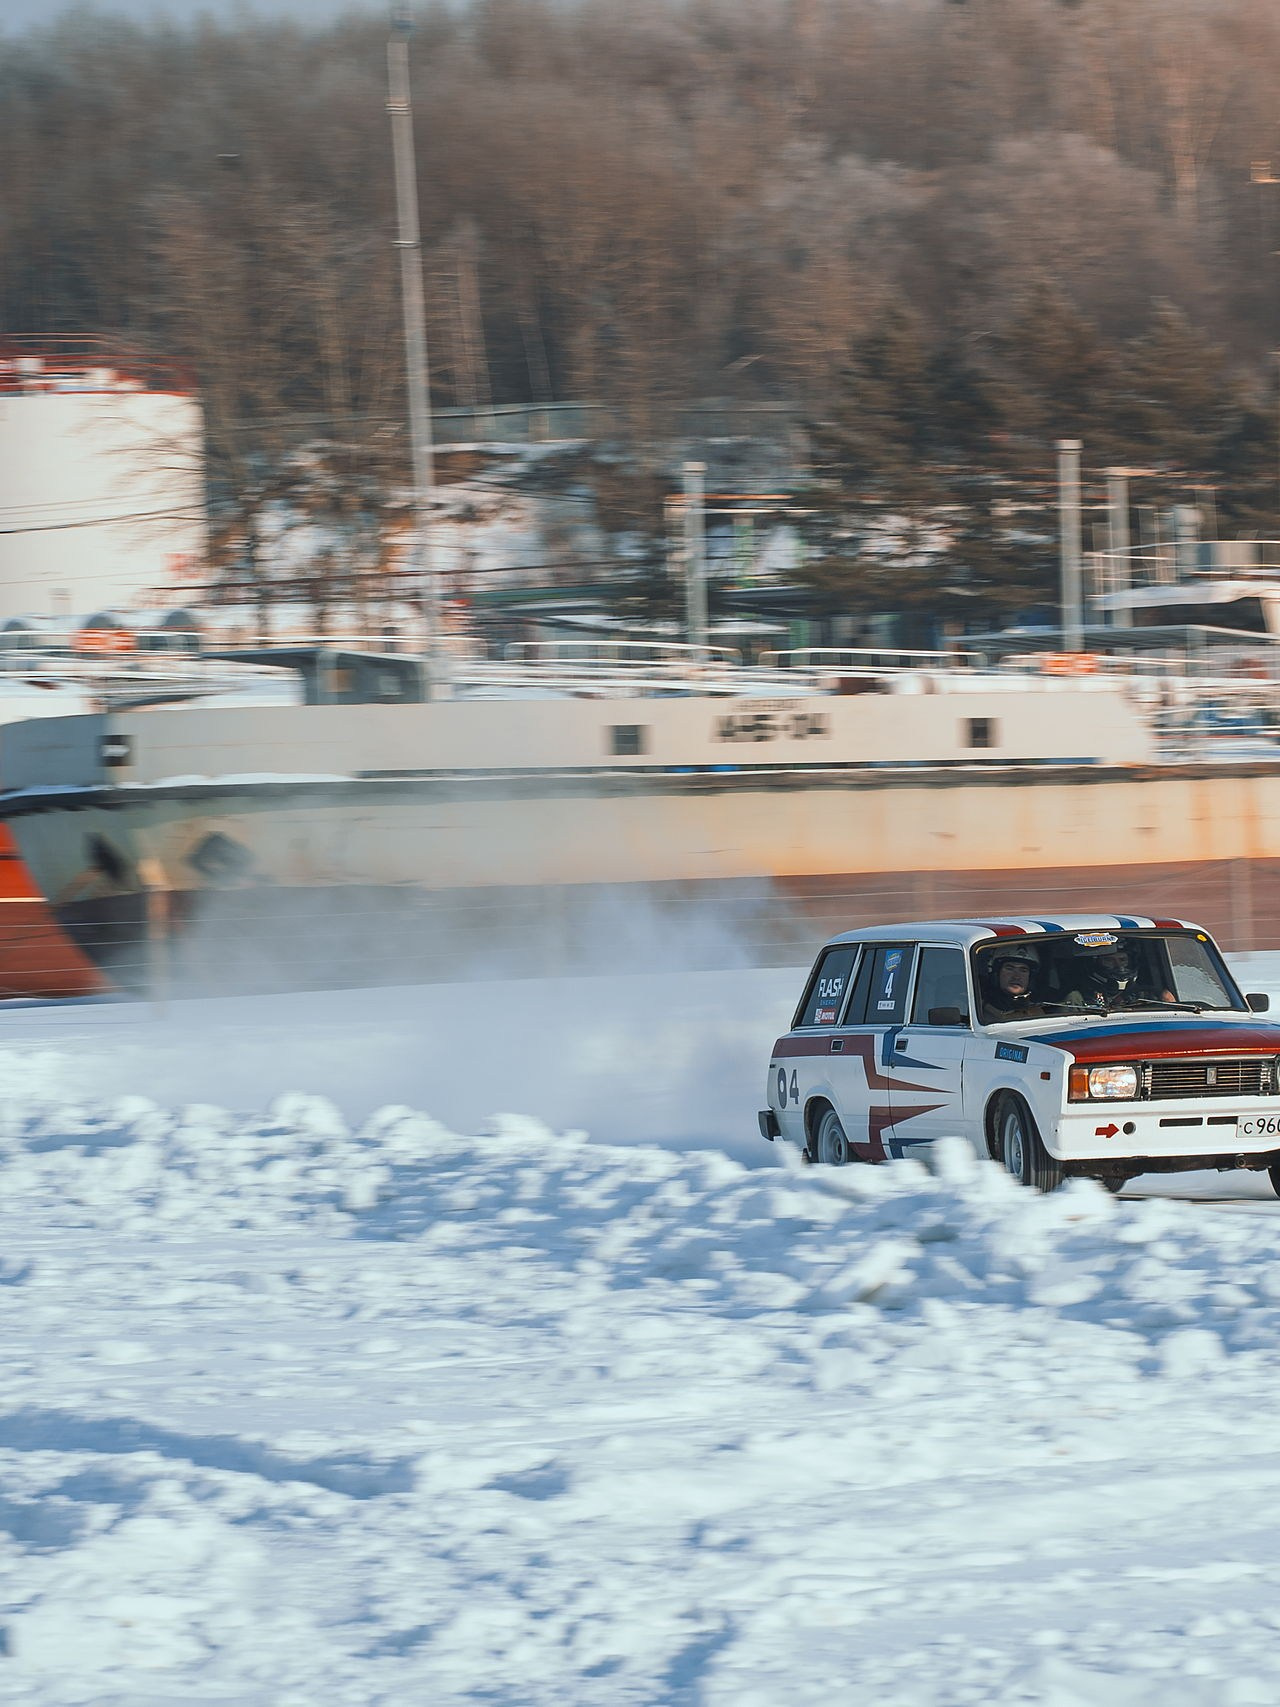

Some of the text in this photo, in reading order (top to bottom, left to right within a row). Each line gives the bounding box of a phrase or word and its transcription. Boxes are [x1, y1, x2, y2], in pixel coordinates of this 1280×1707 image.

[818, 978, 844, 998] FLASH
[884, 972, 894, 999] 4
[999, 1047, 1025, 1061] ORIGINAL
[777, 1067, 799, 1109] 04
